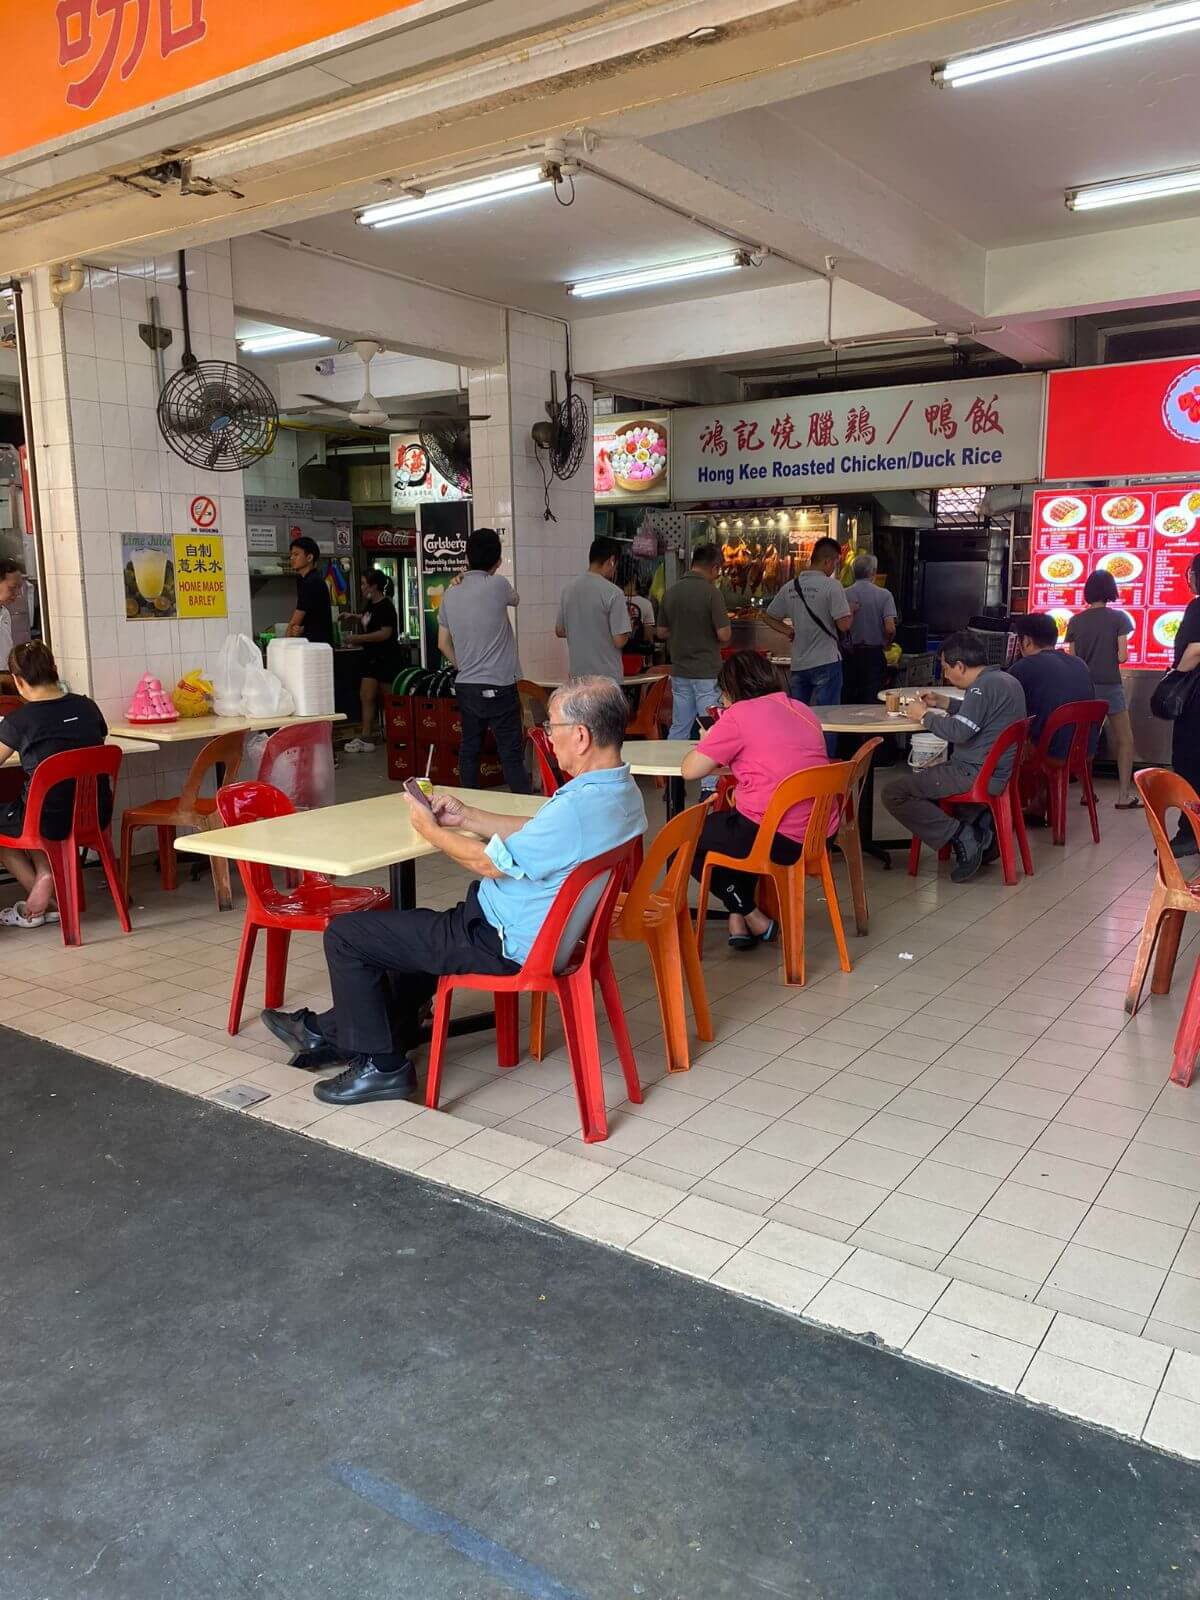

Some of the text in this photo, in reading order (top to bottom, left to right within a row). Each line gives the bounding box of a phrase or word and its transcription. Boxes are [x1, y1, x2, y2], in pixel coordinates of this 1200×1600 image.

[698, 446, 1003, 485] Hong Kee Roasted Chicken/Duck Rice
[424, 533, 467, 554] Carlsberg
[179, 581, 224, 592] HOME MADE
[189, 595, 216, 607] BARLEY
